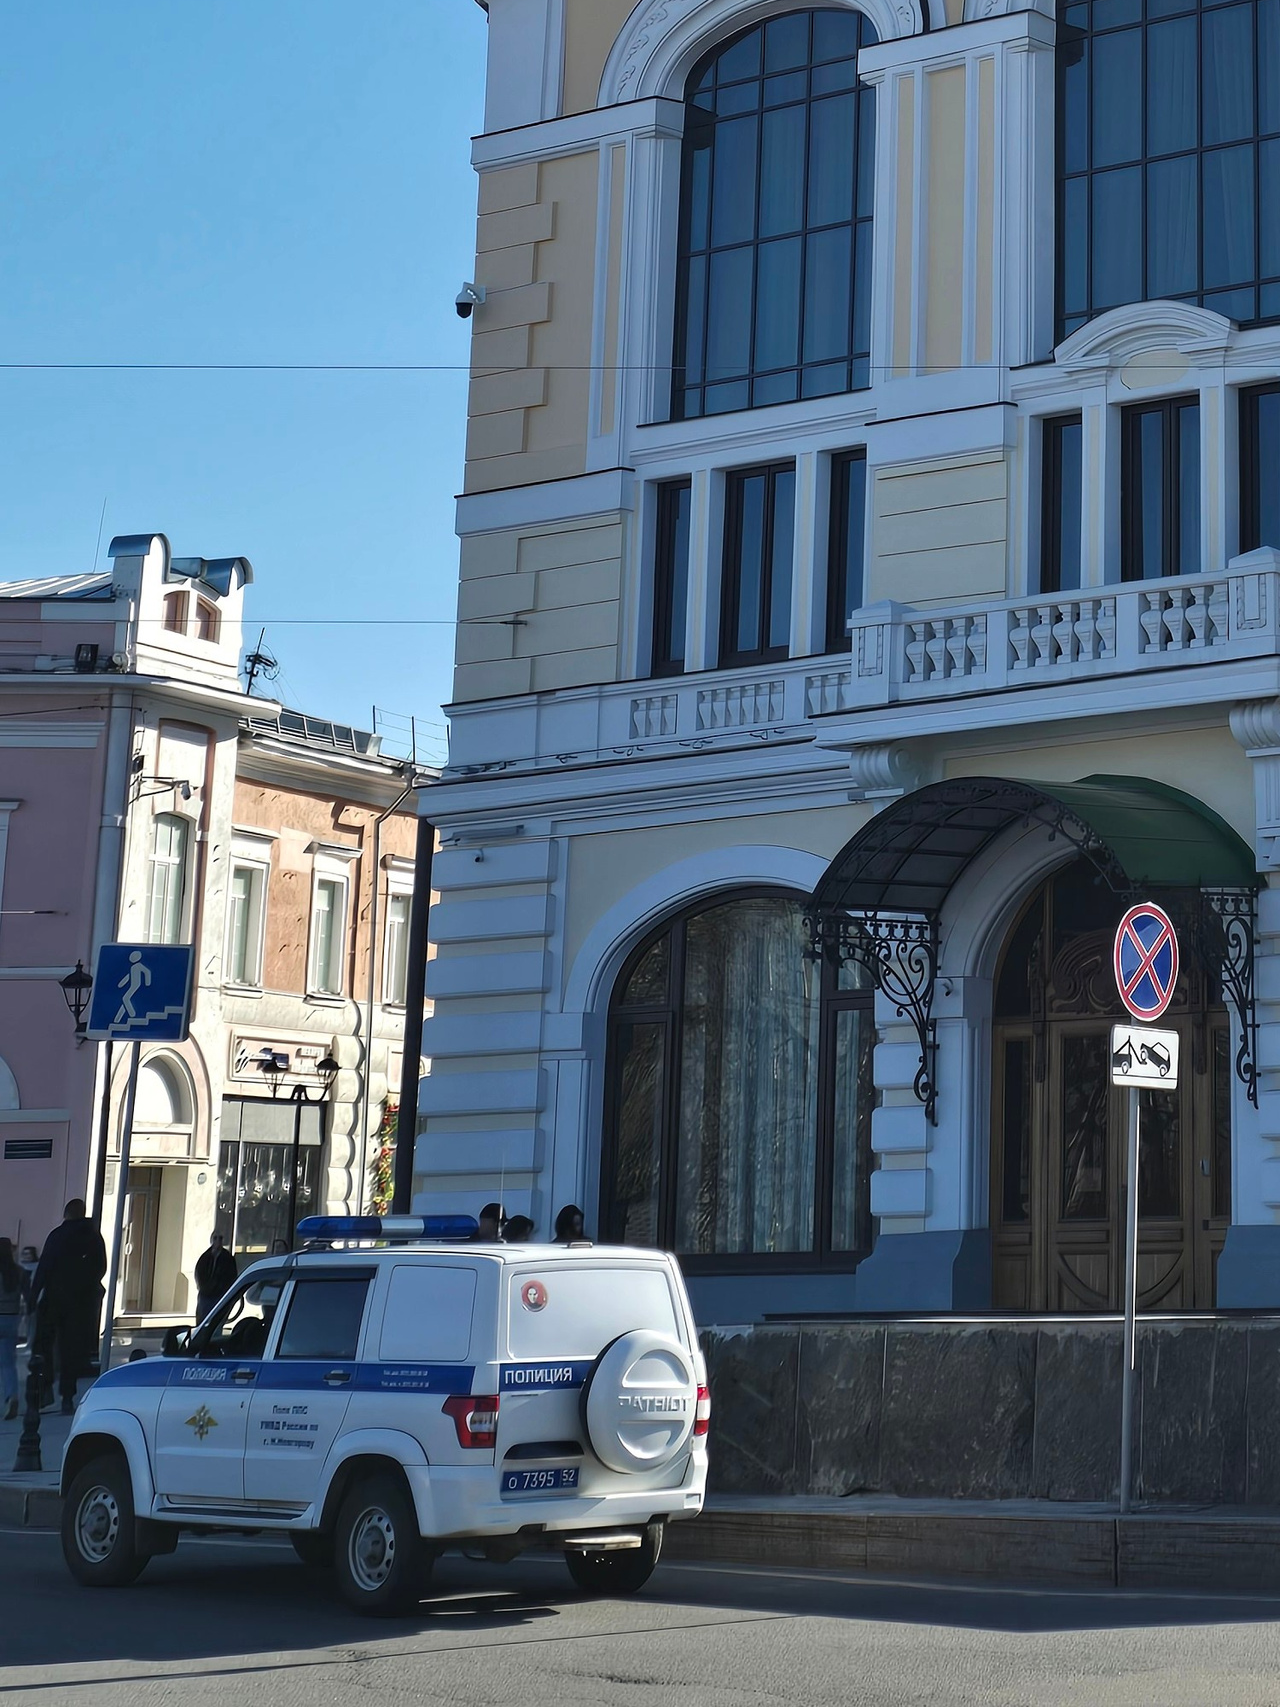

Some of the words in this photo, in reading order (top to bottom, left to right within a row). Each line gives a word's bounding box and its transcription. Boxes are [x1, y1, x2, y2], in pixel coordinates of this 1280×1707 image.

[504, 1367, 573, 1385] ПОЛИЦИЯ
[522, 1471, 555, 1489] 7395
[562, 1469, 575, 1482] 52
